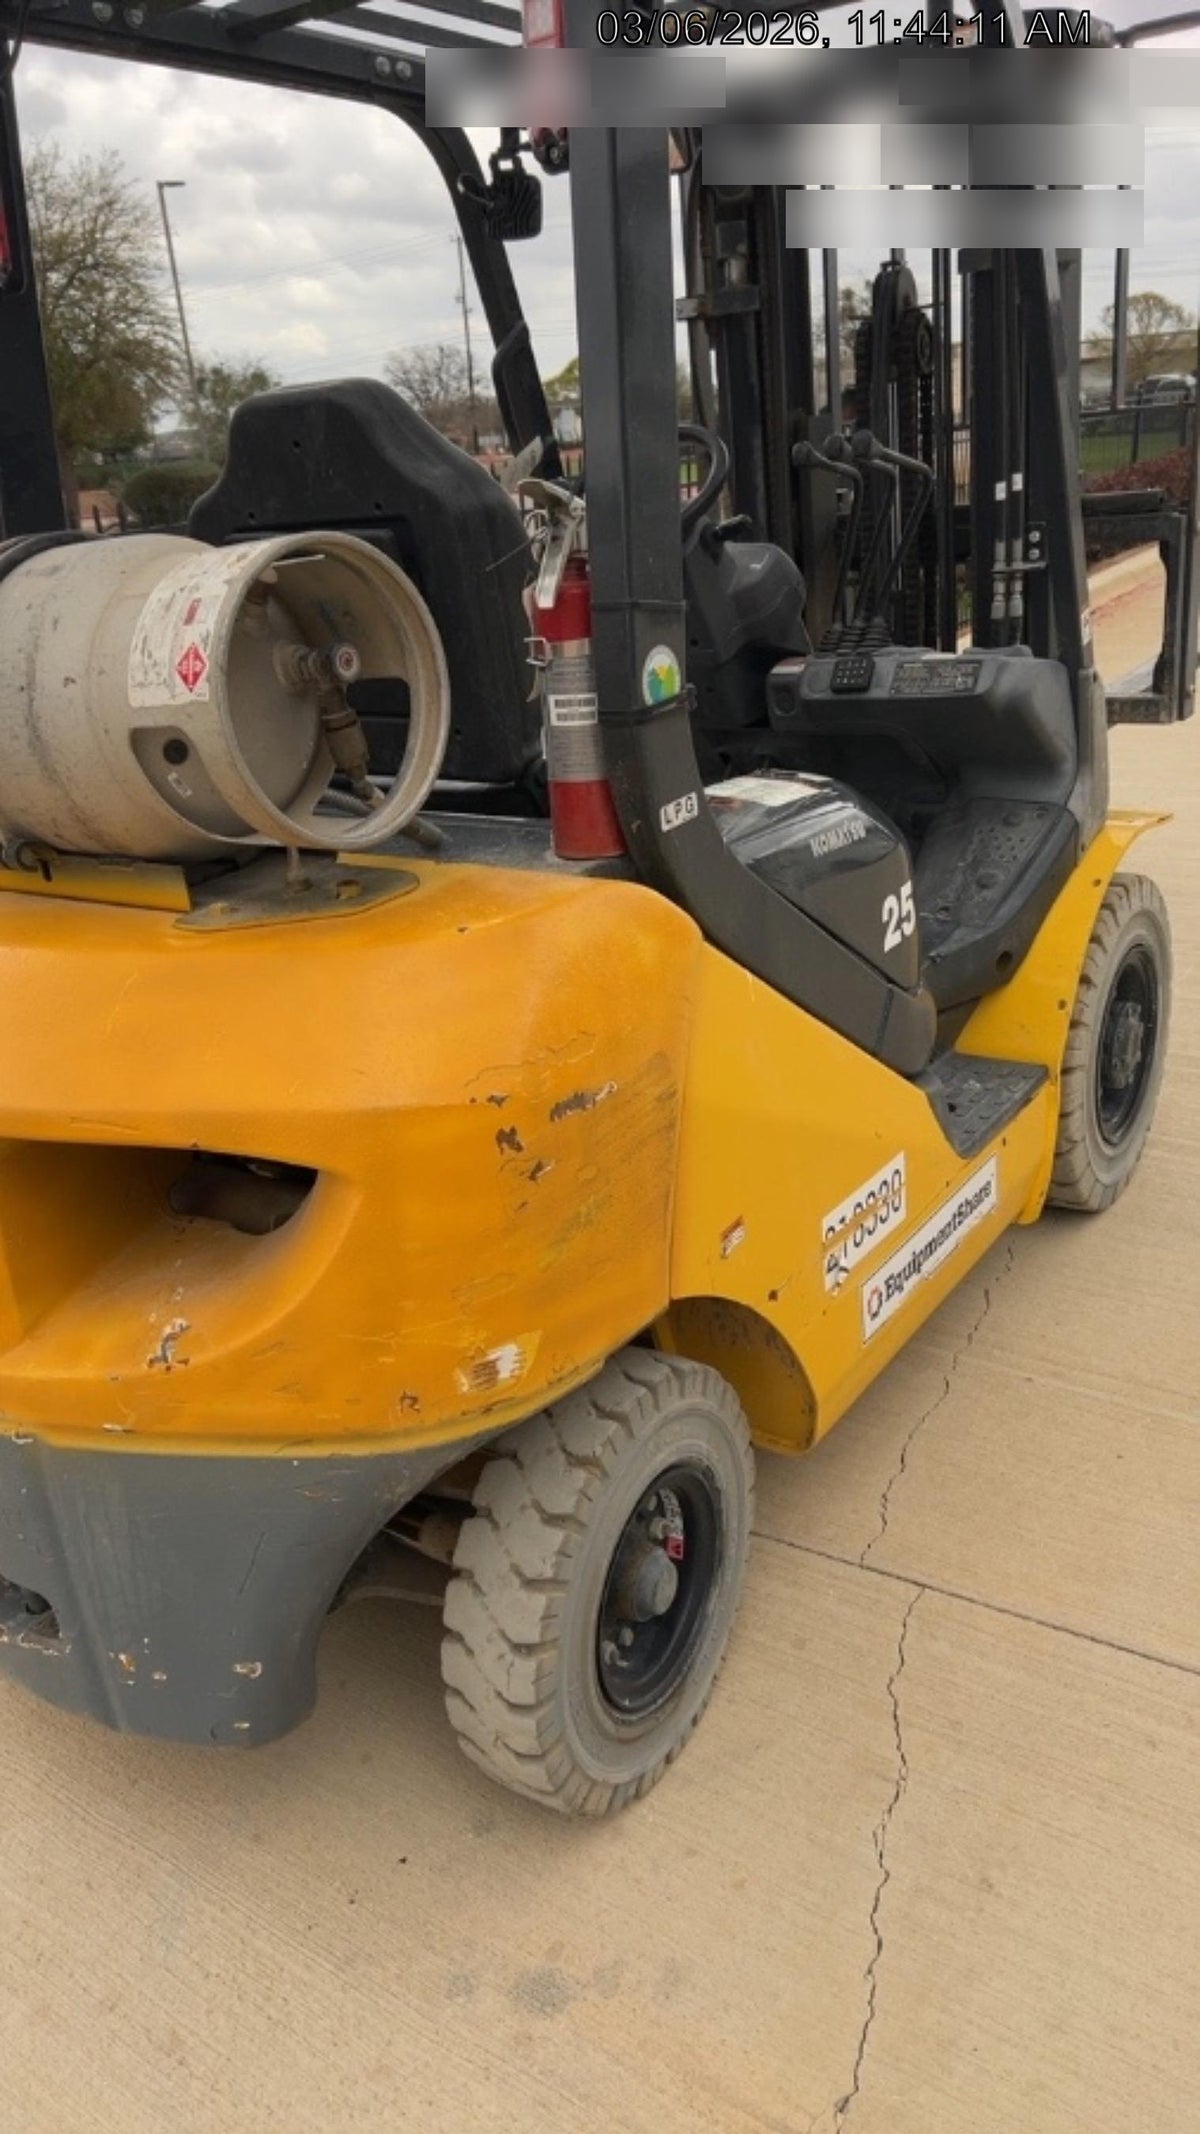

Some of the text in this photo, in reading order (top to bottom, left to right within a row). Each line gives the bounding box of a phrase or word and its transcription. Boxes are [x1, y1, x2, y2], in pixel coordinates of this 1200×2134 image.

[663, 795, 696, 826] LPG
[810, 820, 867, 857] KOMATSU
[881, 880, 917, 953] 25
[883, 1178, 994, 1300] EquipmentShare
